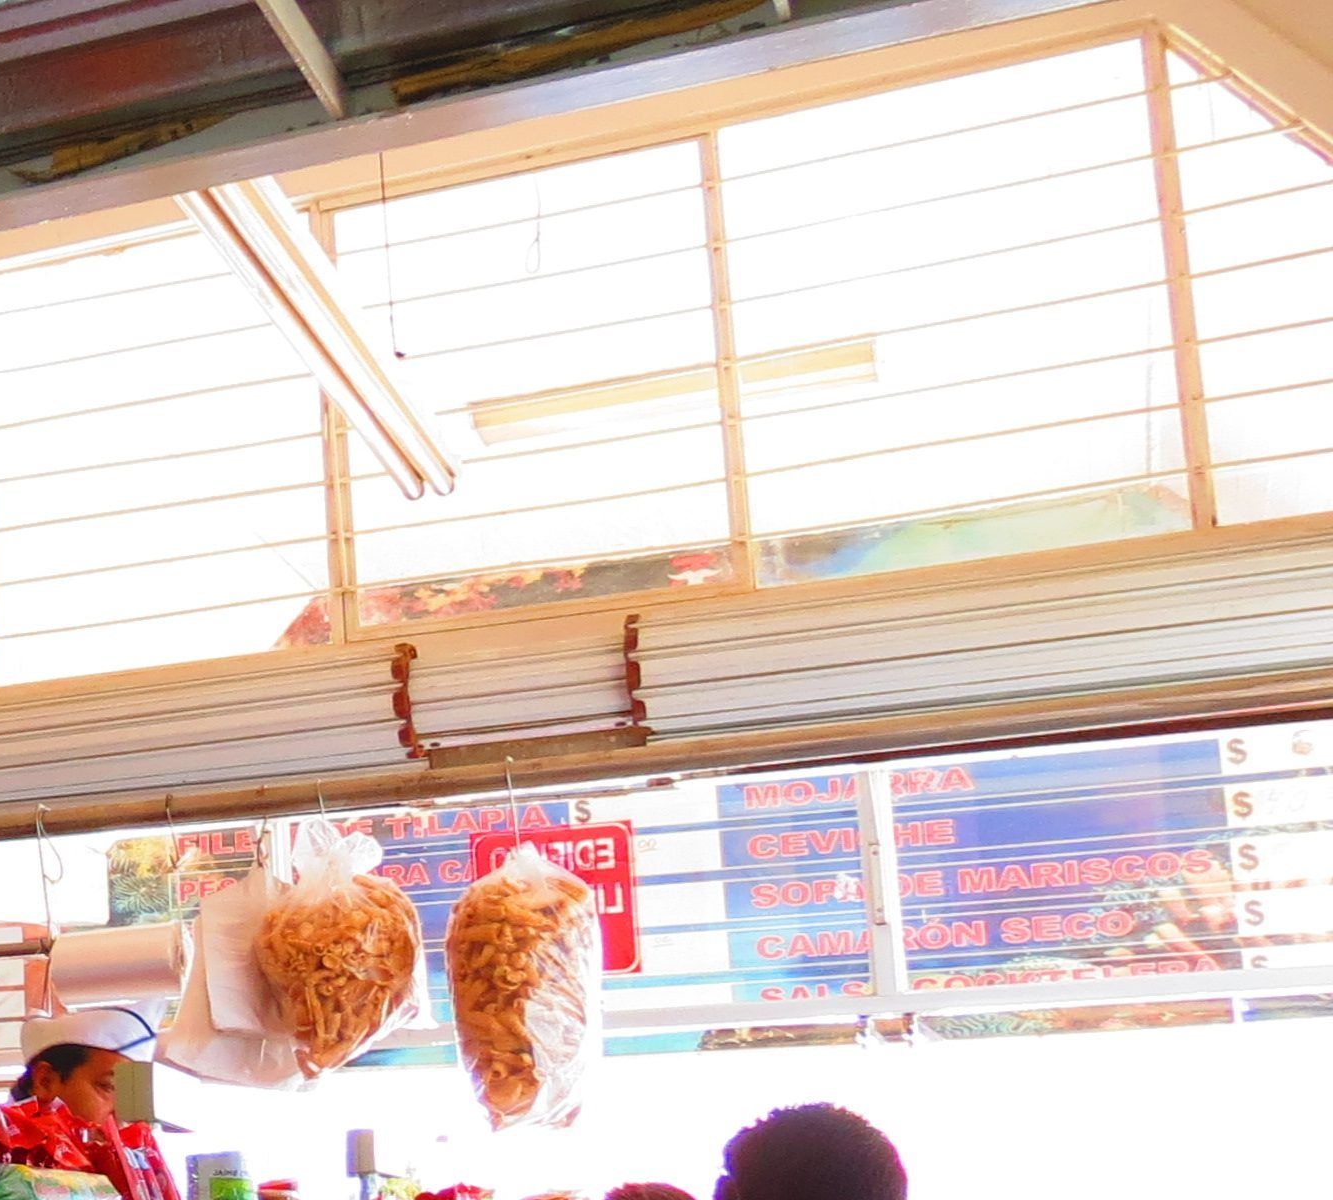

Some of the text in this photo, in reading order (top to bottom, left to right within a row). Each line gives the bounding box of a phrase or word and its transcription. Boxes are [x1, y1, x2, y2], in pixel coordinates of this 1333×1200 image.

[747, 818, 957, 859] CEVIHE
[957, 848, 1214, 895] MARISCOS
[1000, 910, 1135, 945] SECO
